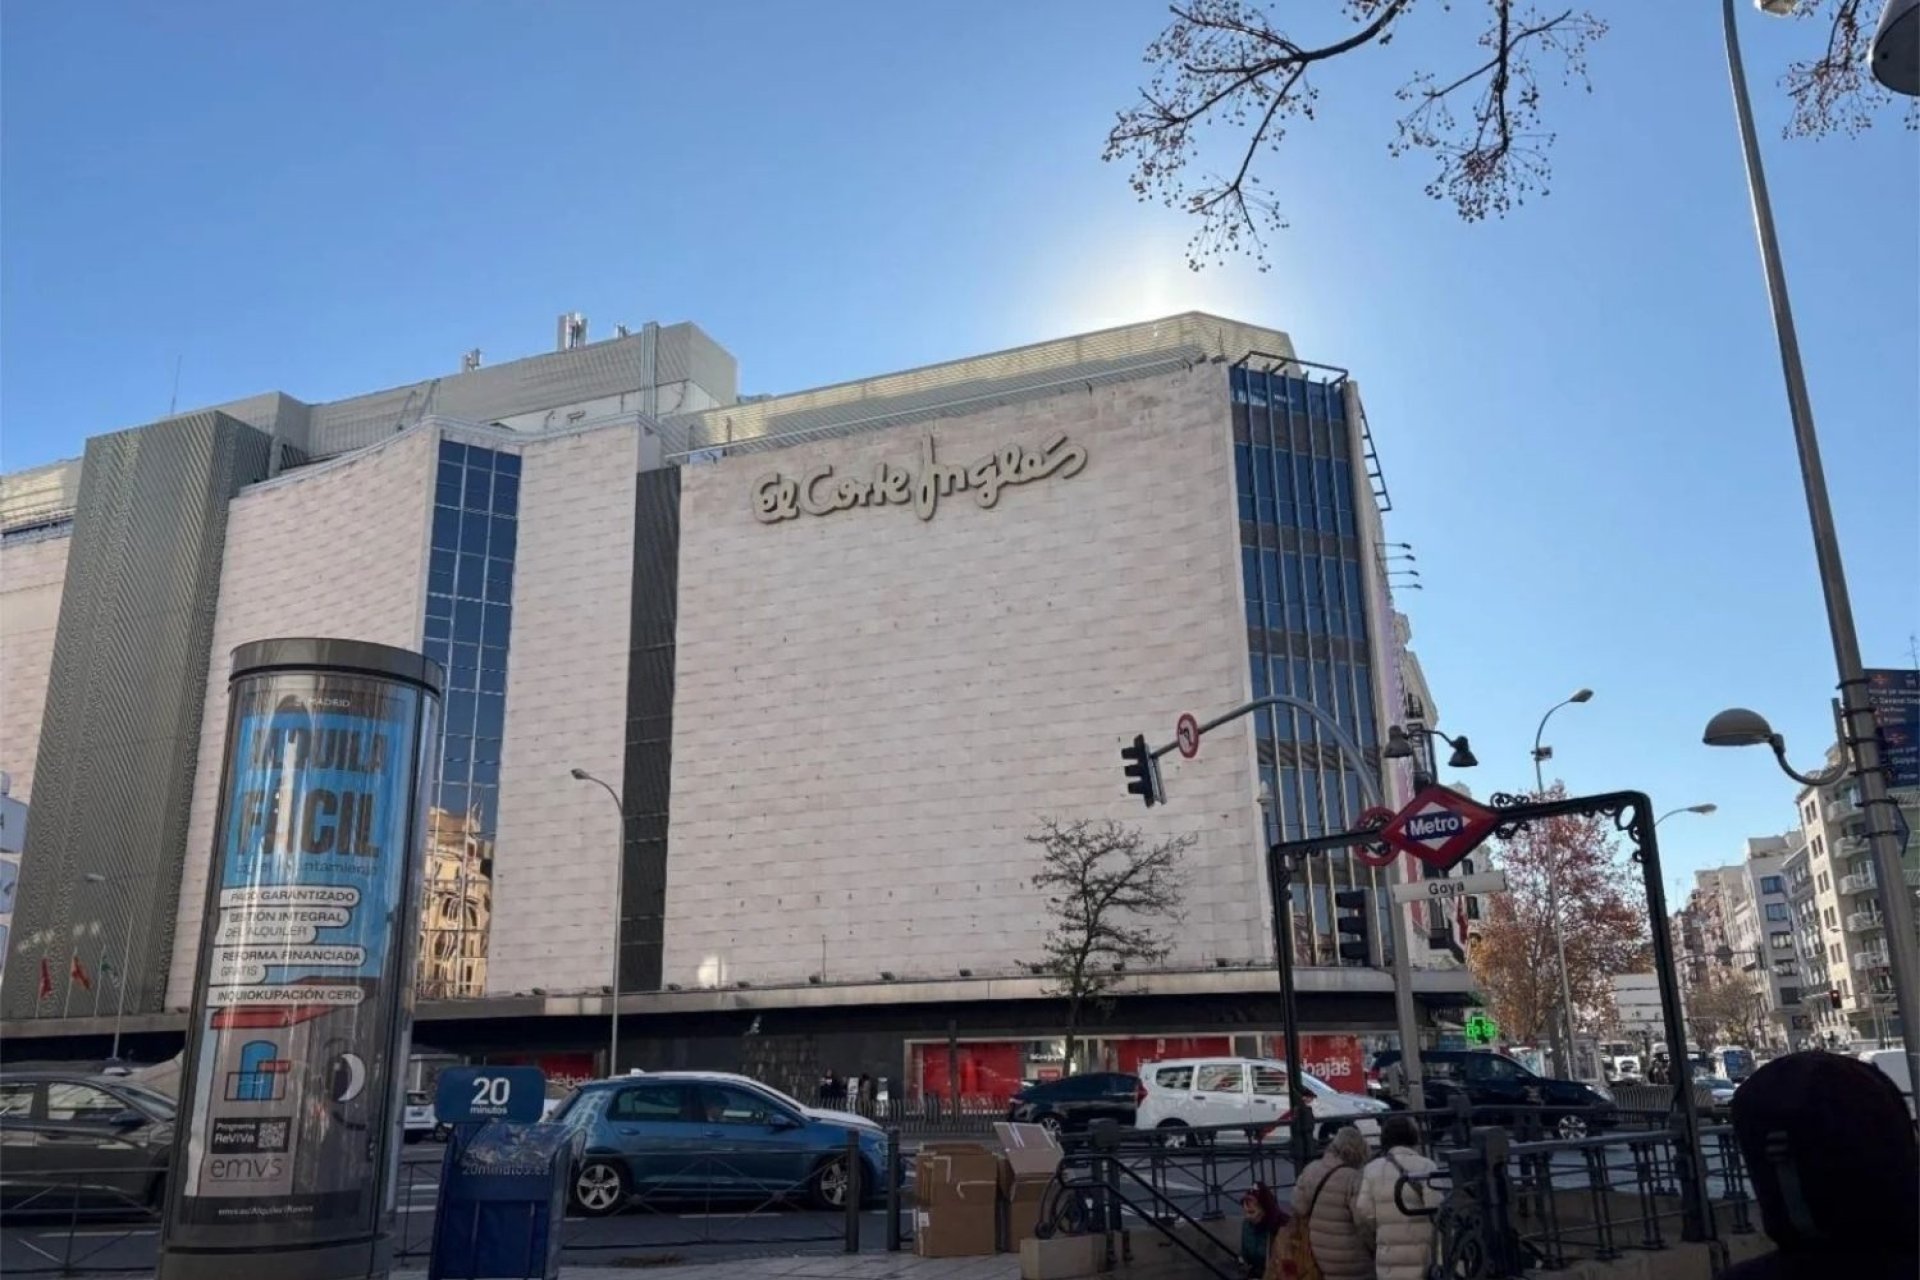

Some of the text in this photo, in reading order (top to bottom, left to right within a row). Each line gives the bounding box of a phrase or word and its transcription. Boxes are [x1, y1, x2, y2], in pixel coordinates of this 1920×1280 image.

[752, 473, 799, 524] El
[801, 462, 911, 516] Corte
[1409, 818, 1460, 836] Metro
[1428, 880, 1465, 896] Goya
[260, 890, 355, 902] GARANTIZADO
[278, 911, 344, 923] INTEGRAL
[281, 951, 361, 962] FINANCIADA
[327, 990, 362, 1000] CERO
[471, 1077, 511, 1105] 20
[470, 1105, 508, 1115] minutos
[210, 1158, 283, 1178] emvs
